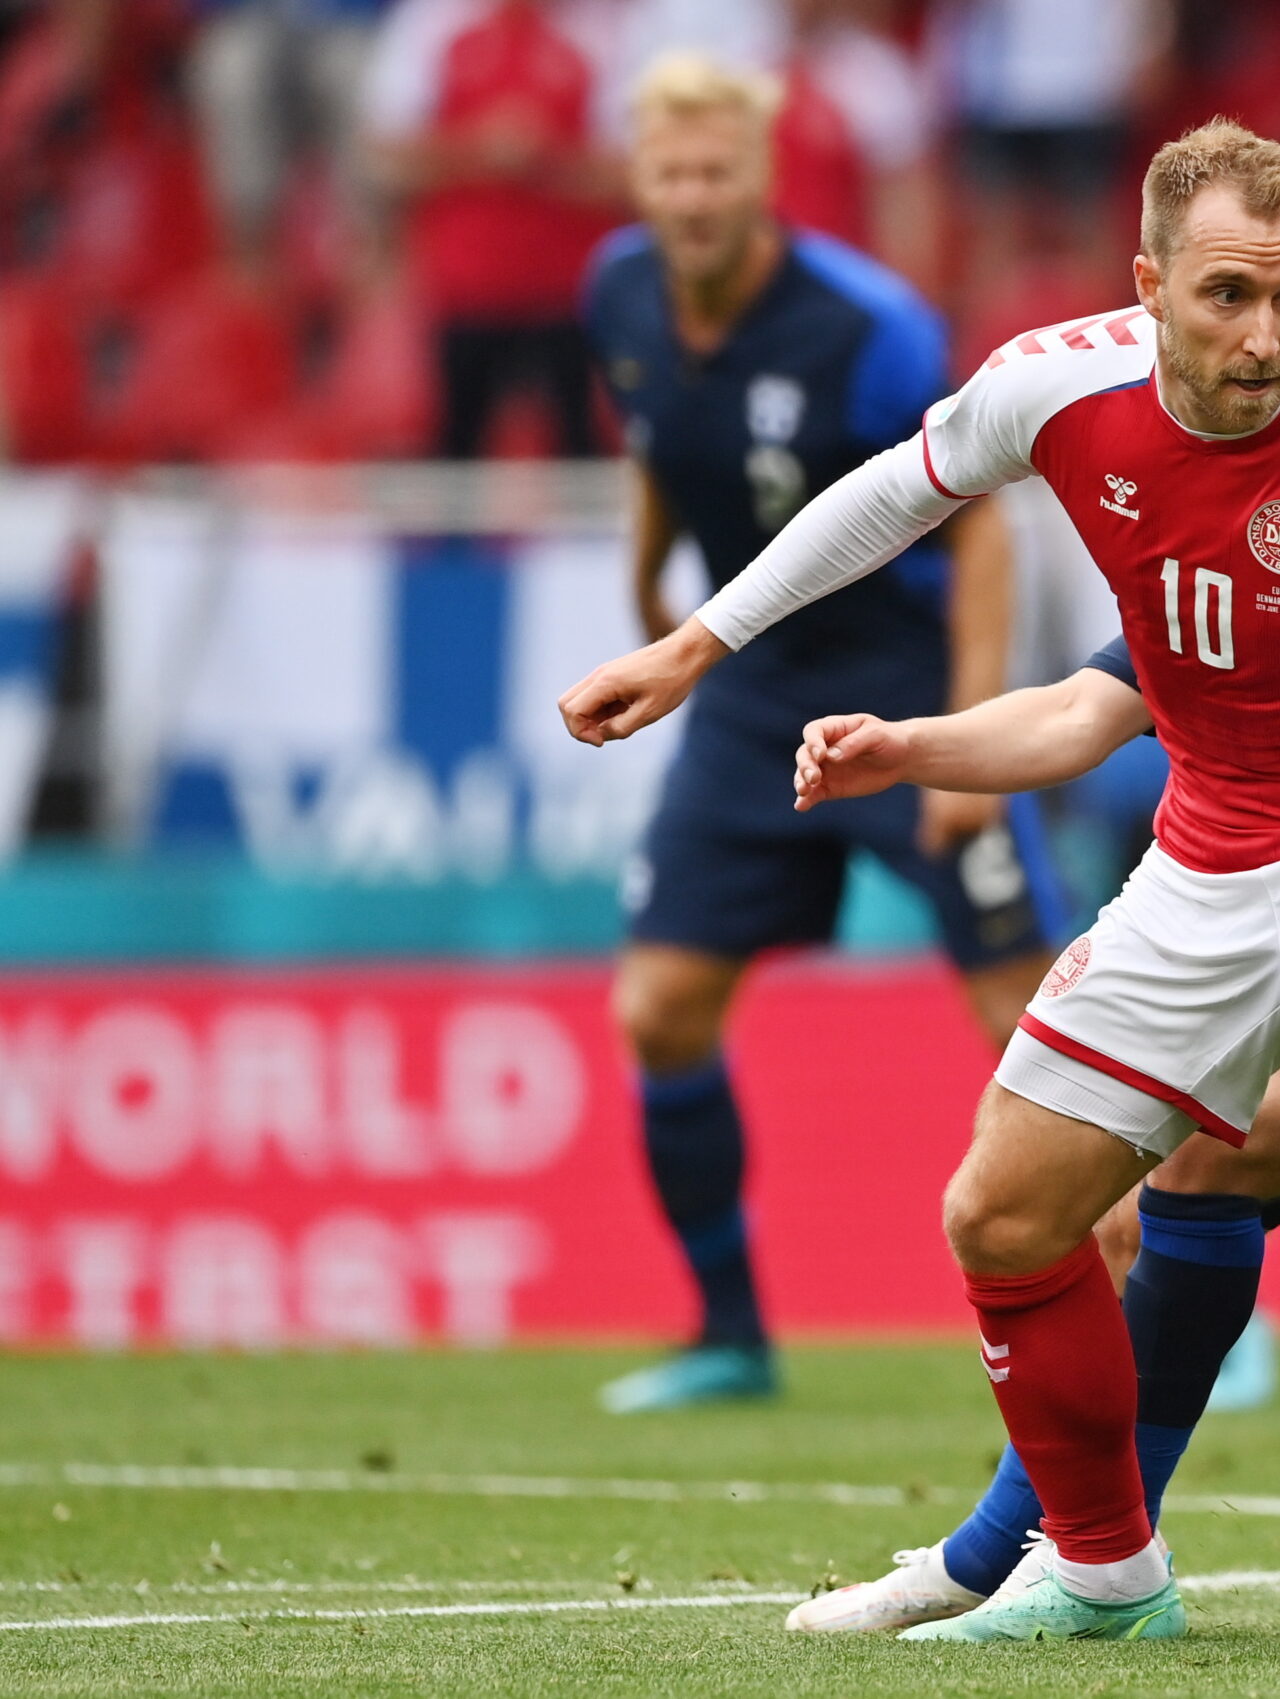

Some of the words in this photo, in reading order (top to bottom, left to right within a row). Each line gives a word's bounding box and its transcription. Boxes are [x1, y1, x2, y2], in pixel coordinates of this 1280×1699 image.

[1100, 495, 1139, 520] hummel
[1251, 515, 1267, 558] DANSK
[1160, 557, 1235, 669] 10
